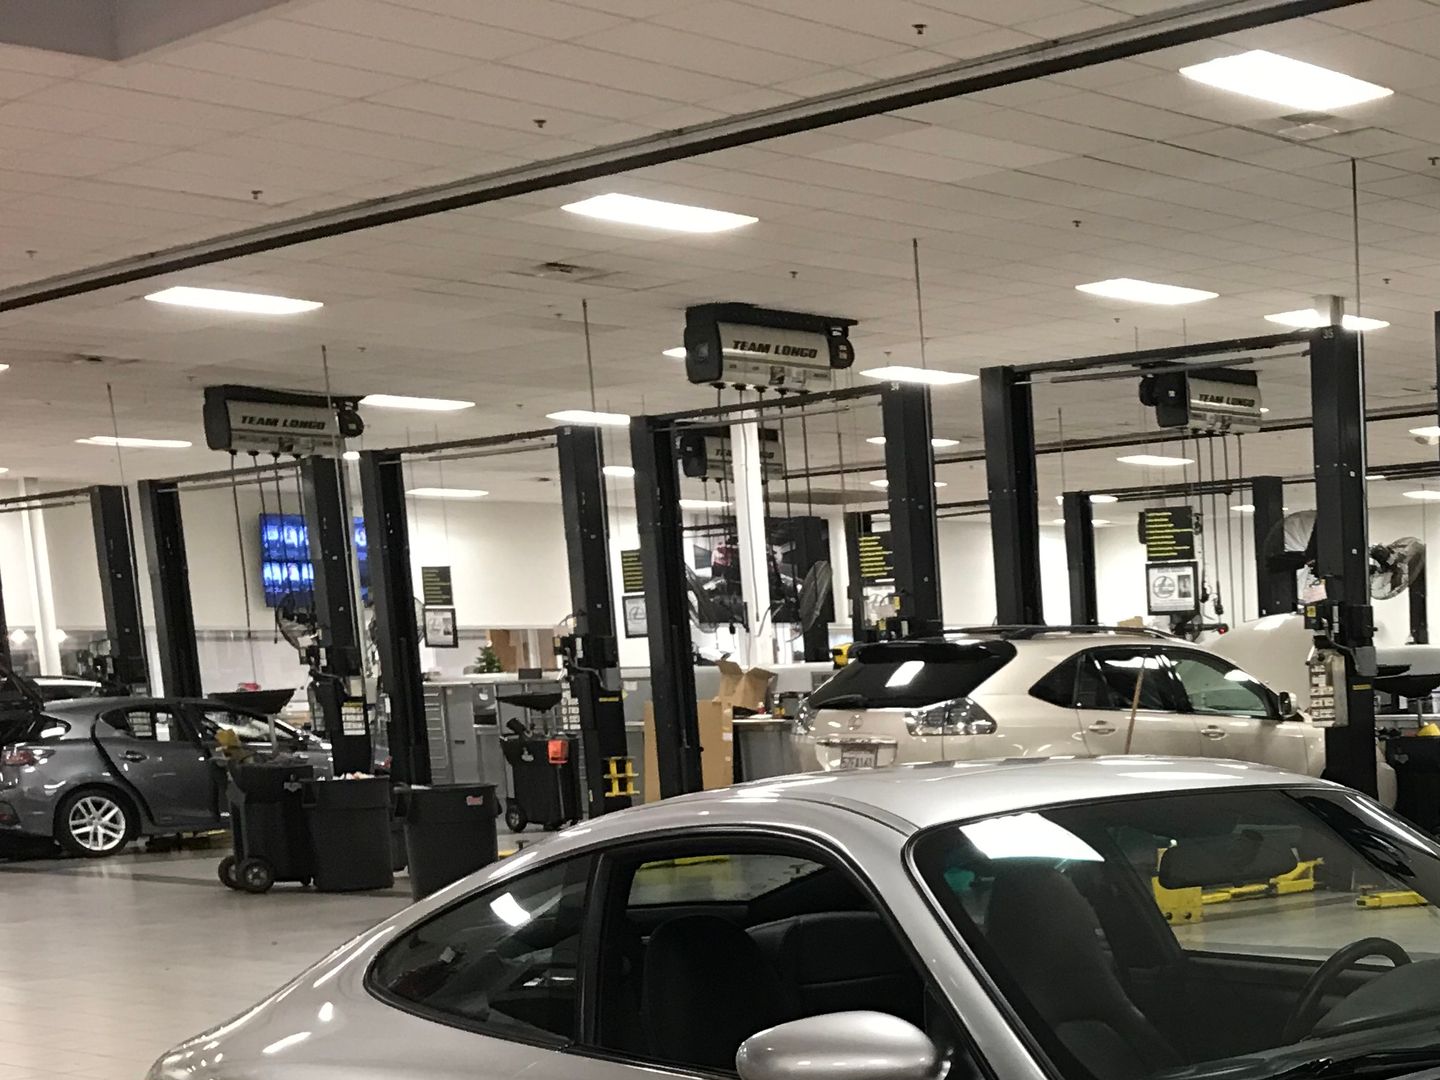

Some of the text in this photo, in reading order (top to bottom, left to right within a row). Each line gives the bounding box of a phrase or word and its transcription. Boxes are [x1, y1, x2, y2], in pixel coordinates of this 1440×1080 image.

[733, 340, 818, 359] TEAM LONGO
[241, 415, 325, 430] TEAM LONGO
